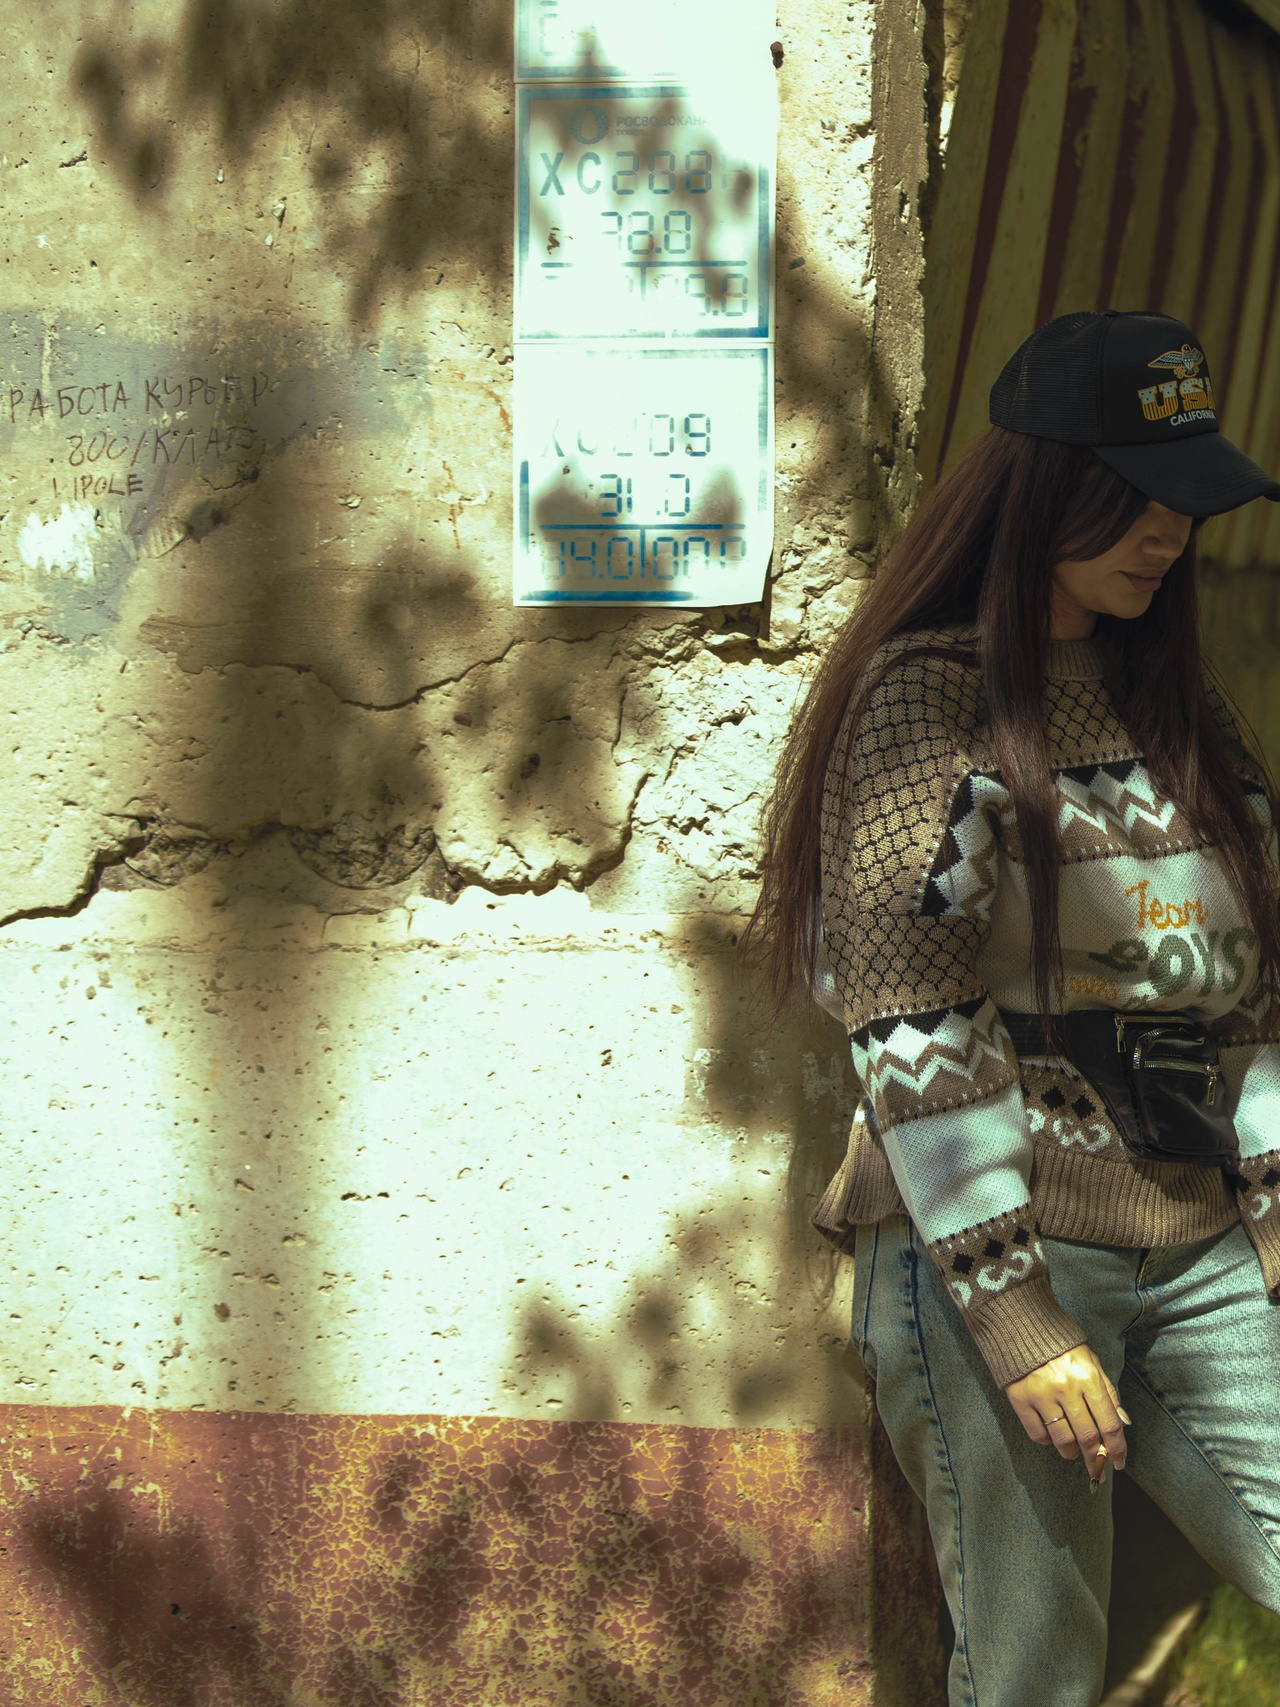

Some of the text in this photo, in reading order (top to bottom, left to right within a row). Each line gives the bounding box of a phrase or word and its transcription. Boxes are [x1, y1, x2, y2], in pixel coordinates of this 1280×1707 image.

[616, 115, 708, 128] РОСВОДОКАН
[9, 371, 270, 424] РАБОТА КУРЬЕР
[1170, 409, 1216, 426] CALIFORNIA
[1125, 879, 1210, 930] Team
